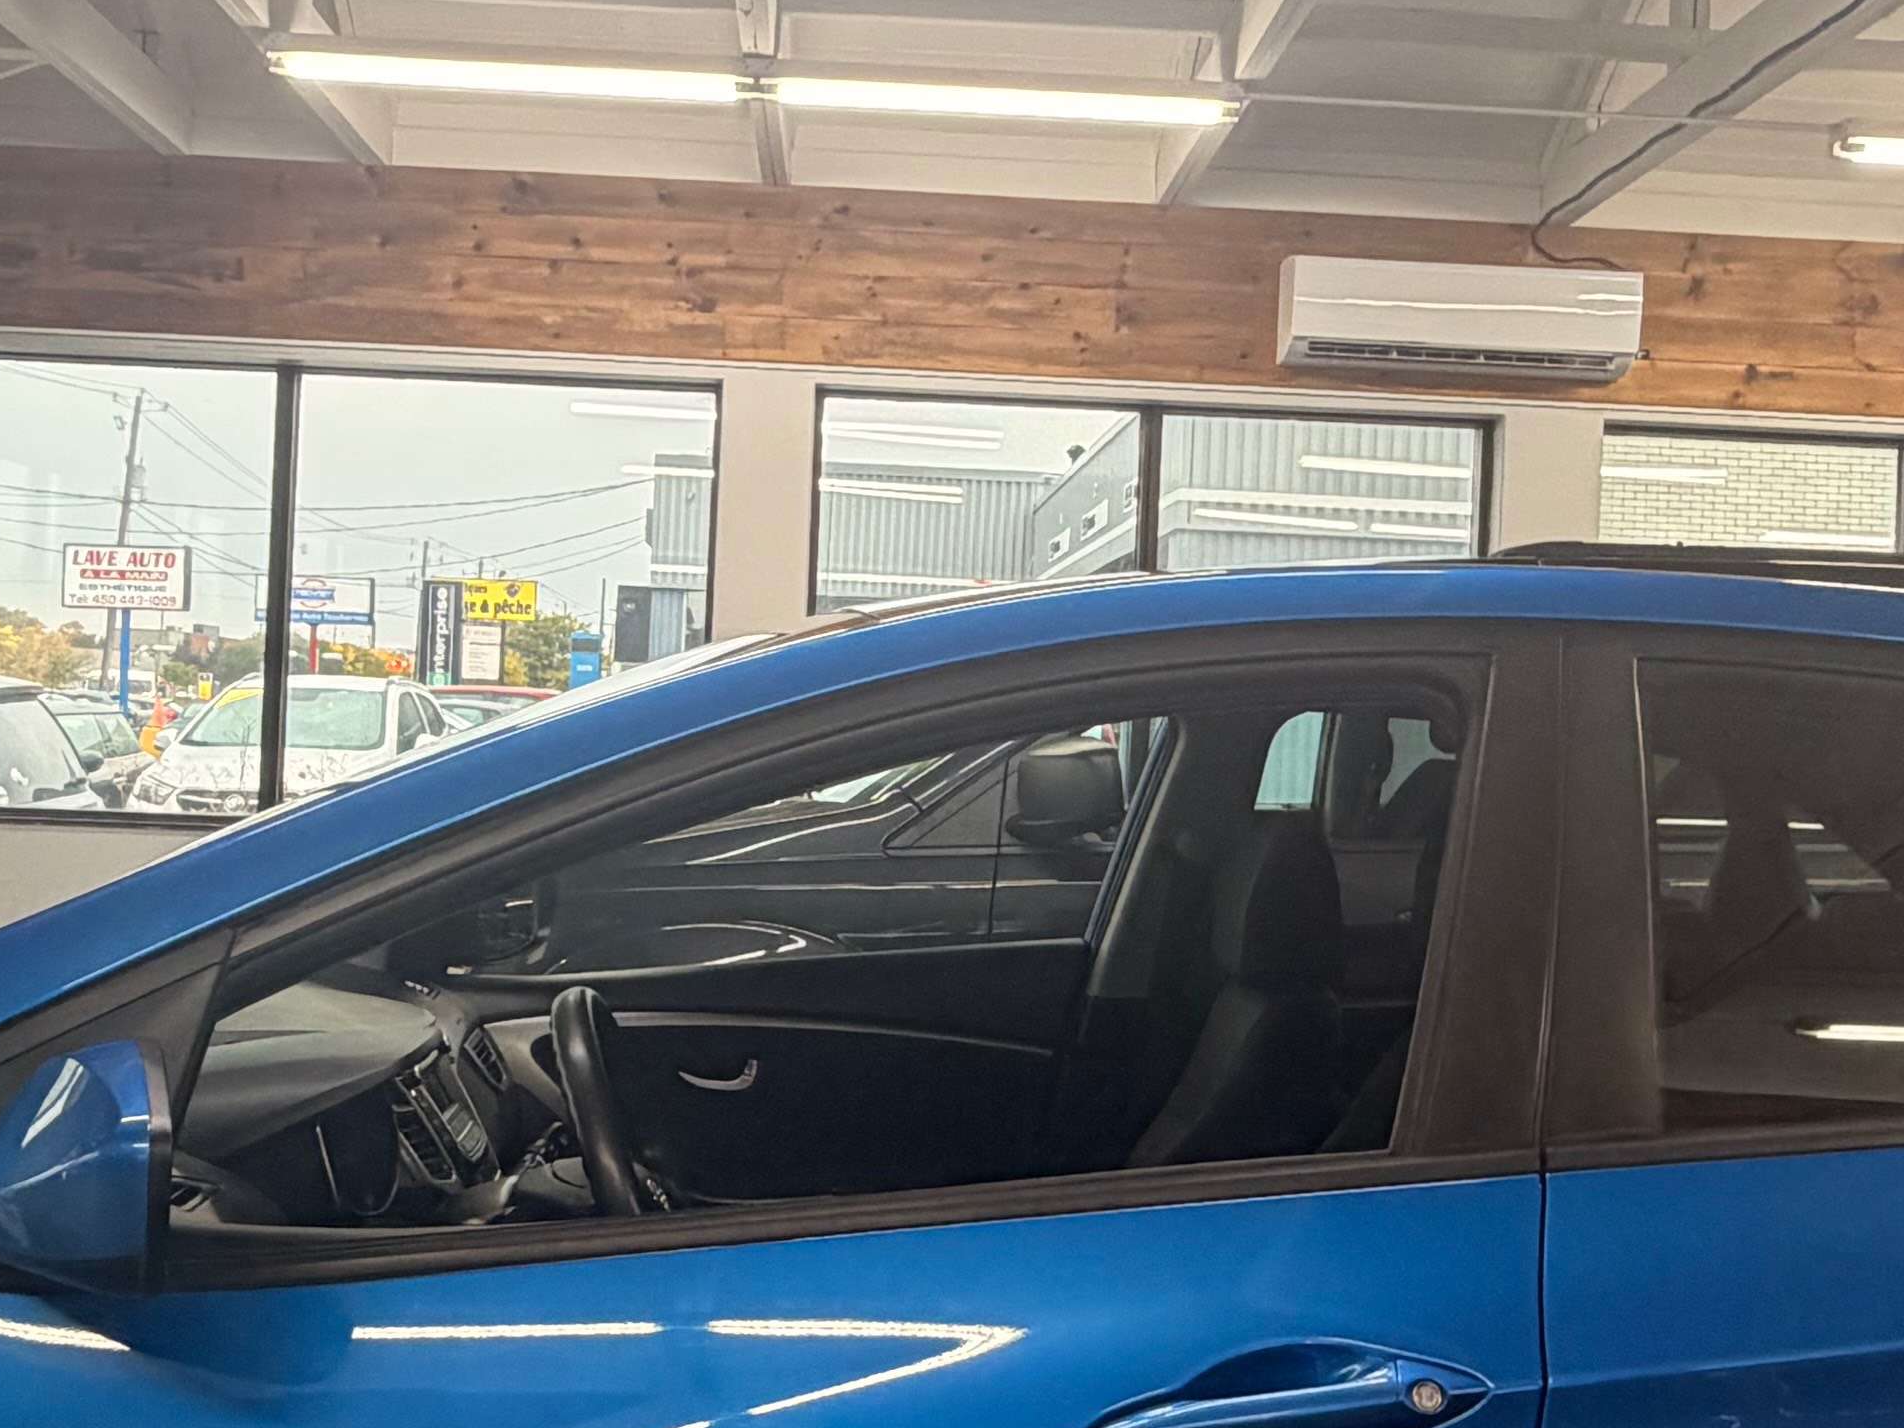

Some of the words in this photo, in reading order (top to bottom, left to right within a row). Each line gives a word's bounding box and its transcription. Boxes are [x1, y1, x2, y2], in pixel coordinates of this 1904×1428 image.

[72, 549, 119, 567] LAVE
[126, 551, 177, 568] AUTO
[92, 594, 116, 605] 450
[494, 599, 532, 618] pêche
[432, 586, 449, 686] enterprise
